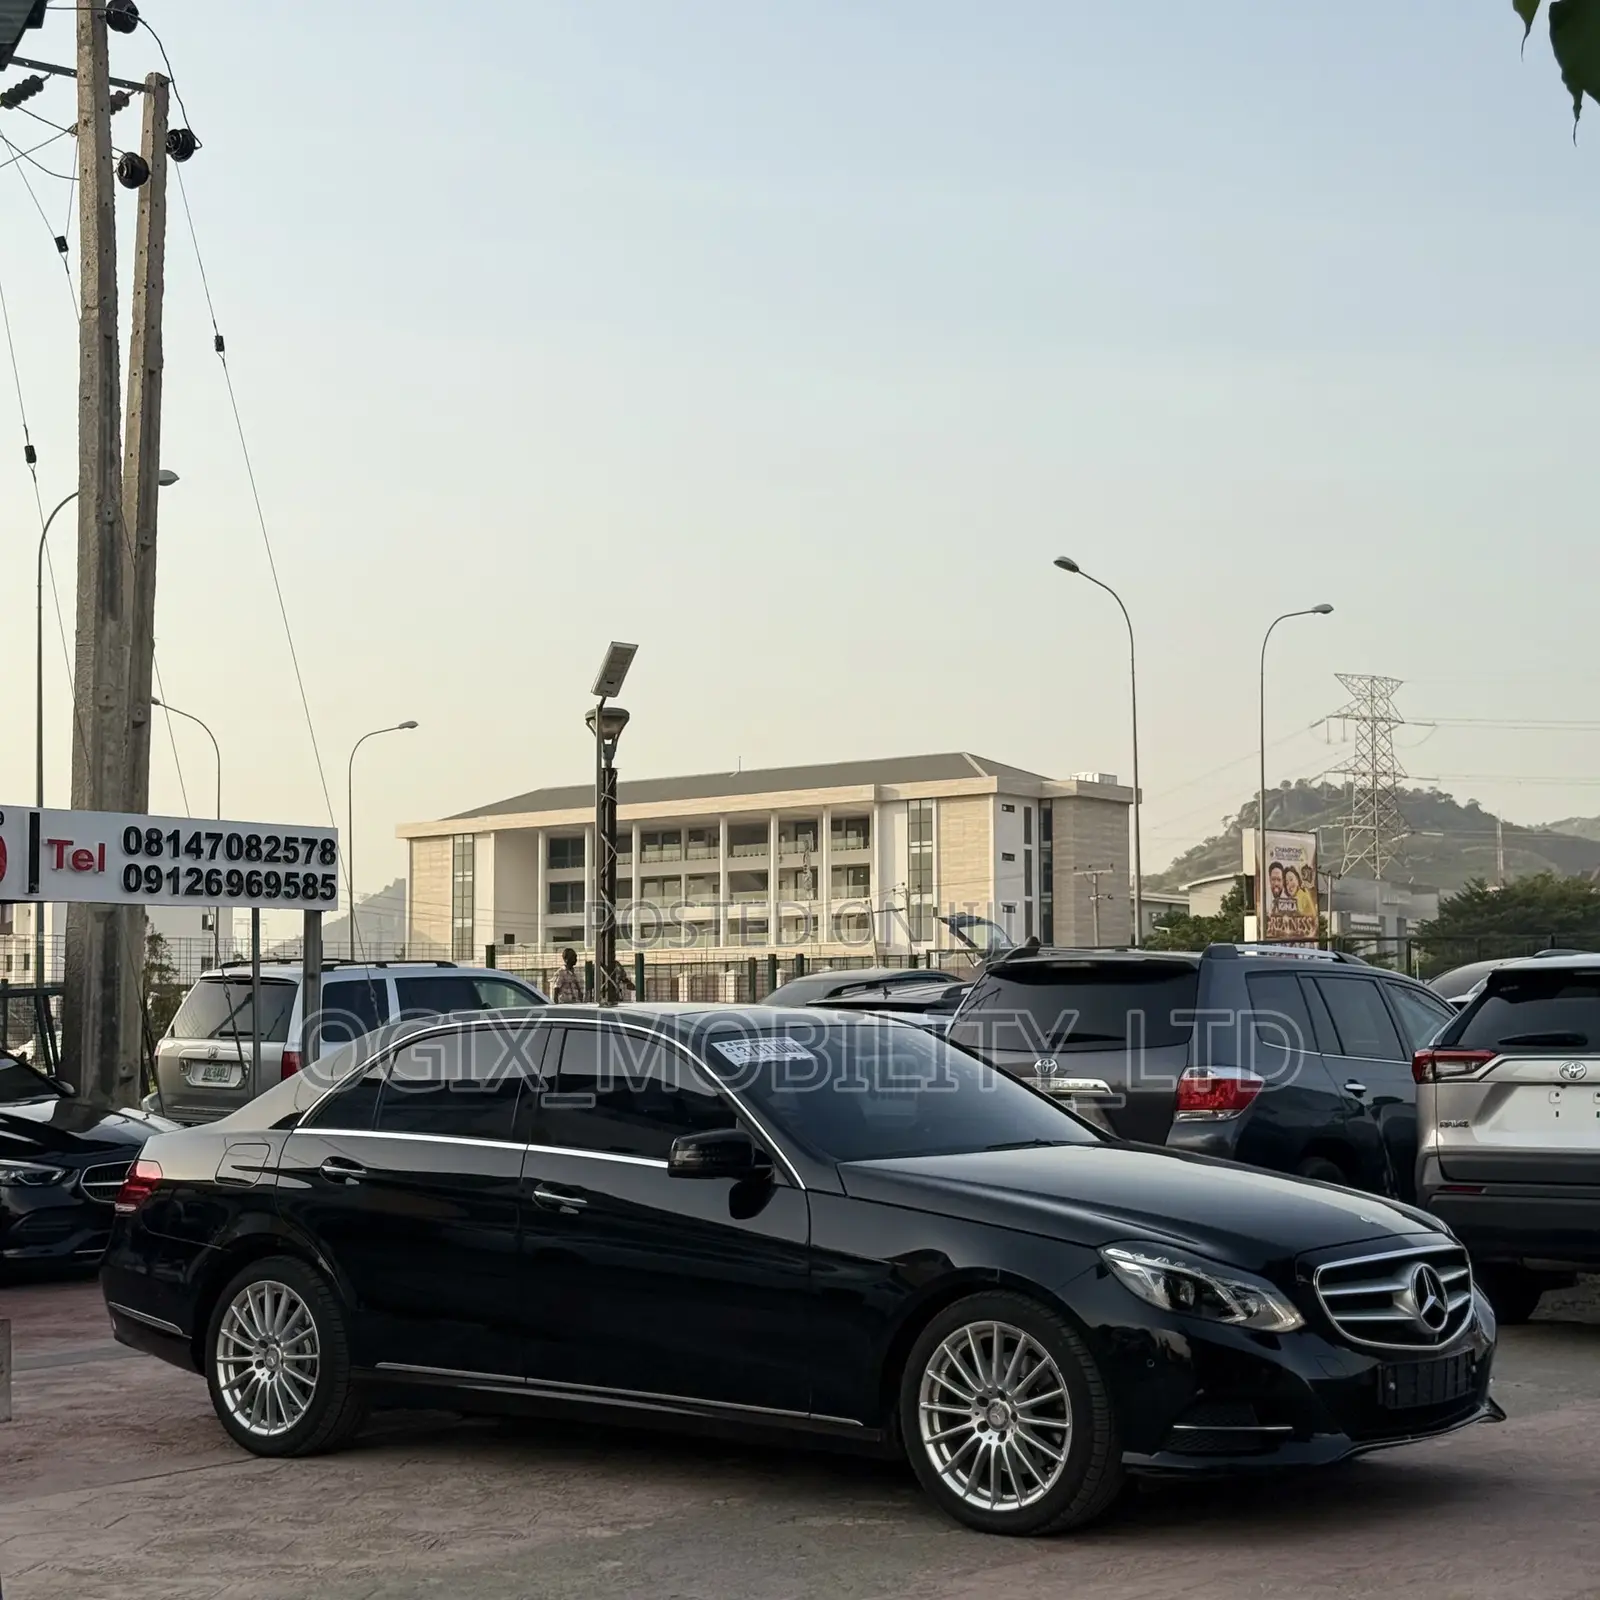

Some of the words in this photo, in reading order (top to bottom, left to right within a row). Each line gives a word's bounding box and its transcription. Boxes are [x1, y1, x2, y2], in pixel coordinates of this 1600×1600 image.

[46, 838, 105, 872] Tel
[122, 825, 336, 866] 08147082578
[122, 863, 336, 901] 09126969585
